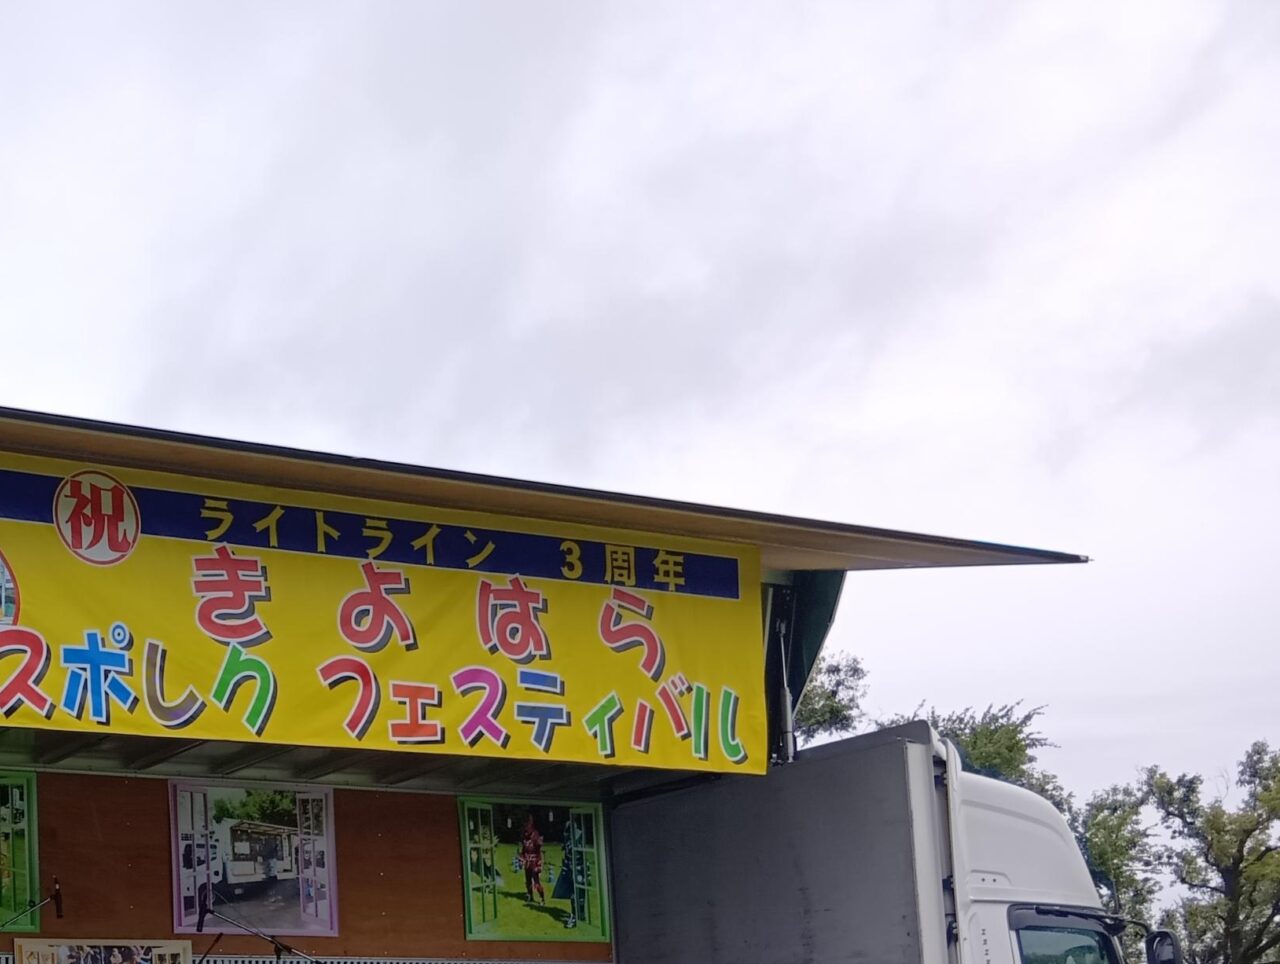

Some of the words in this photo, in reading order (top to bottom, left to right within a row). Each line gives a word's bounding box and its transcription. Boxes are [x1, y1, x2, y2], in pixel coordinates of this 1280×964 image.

[63, 478, 132, 555] 祝
[200, 498, 496, 569] ライトライン
[559, 540, 686, 592] 3周年
[190, 543, 666, 681] きよはら
[316, 654, 750, 764] フェスティバル
